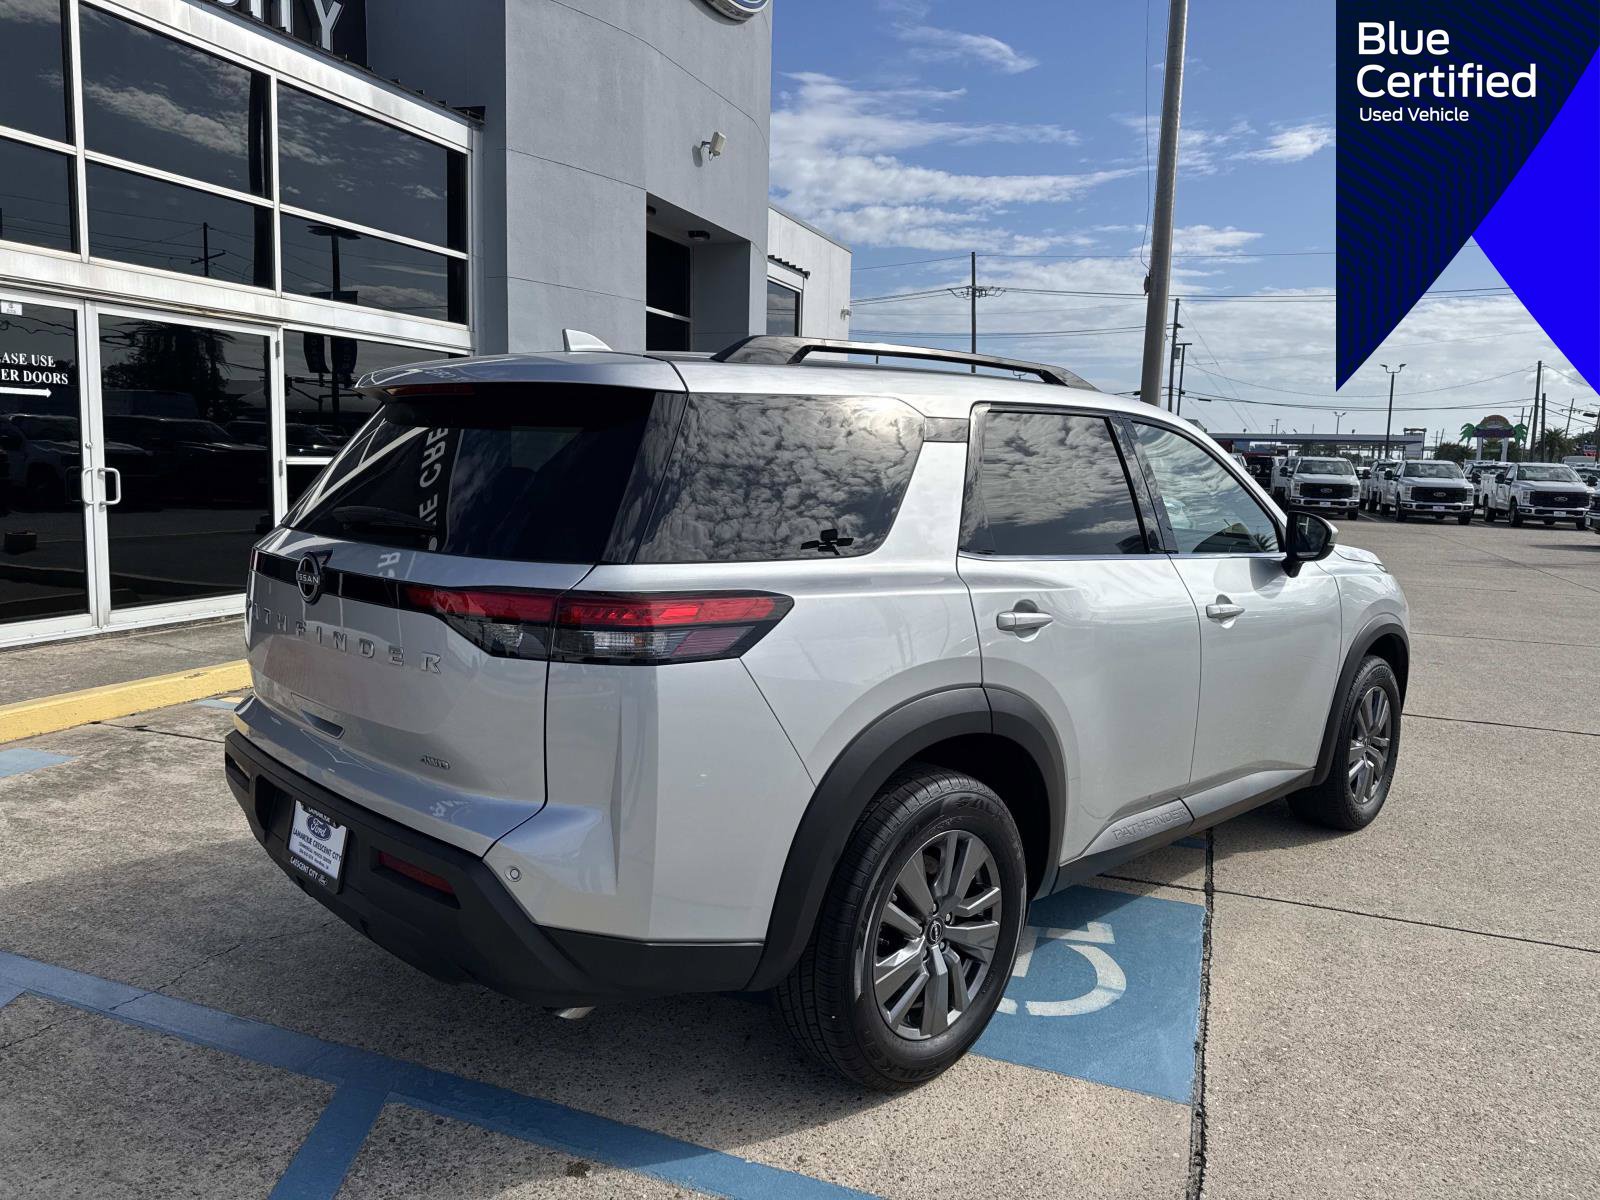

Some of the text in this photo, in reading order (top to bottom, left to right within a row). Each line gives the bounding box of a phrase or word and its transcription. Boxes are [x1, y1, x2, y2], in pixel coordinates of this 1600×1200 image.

[0, 352, 56, 367] ASE USE
[23, 370, 69, 384] DOORS
[1112, 807, 1187, 840] PATHFINDER
